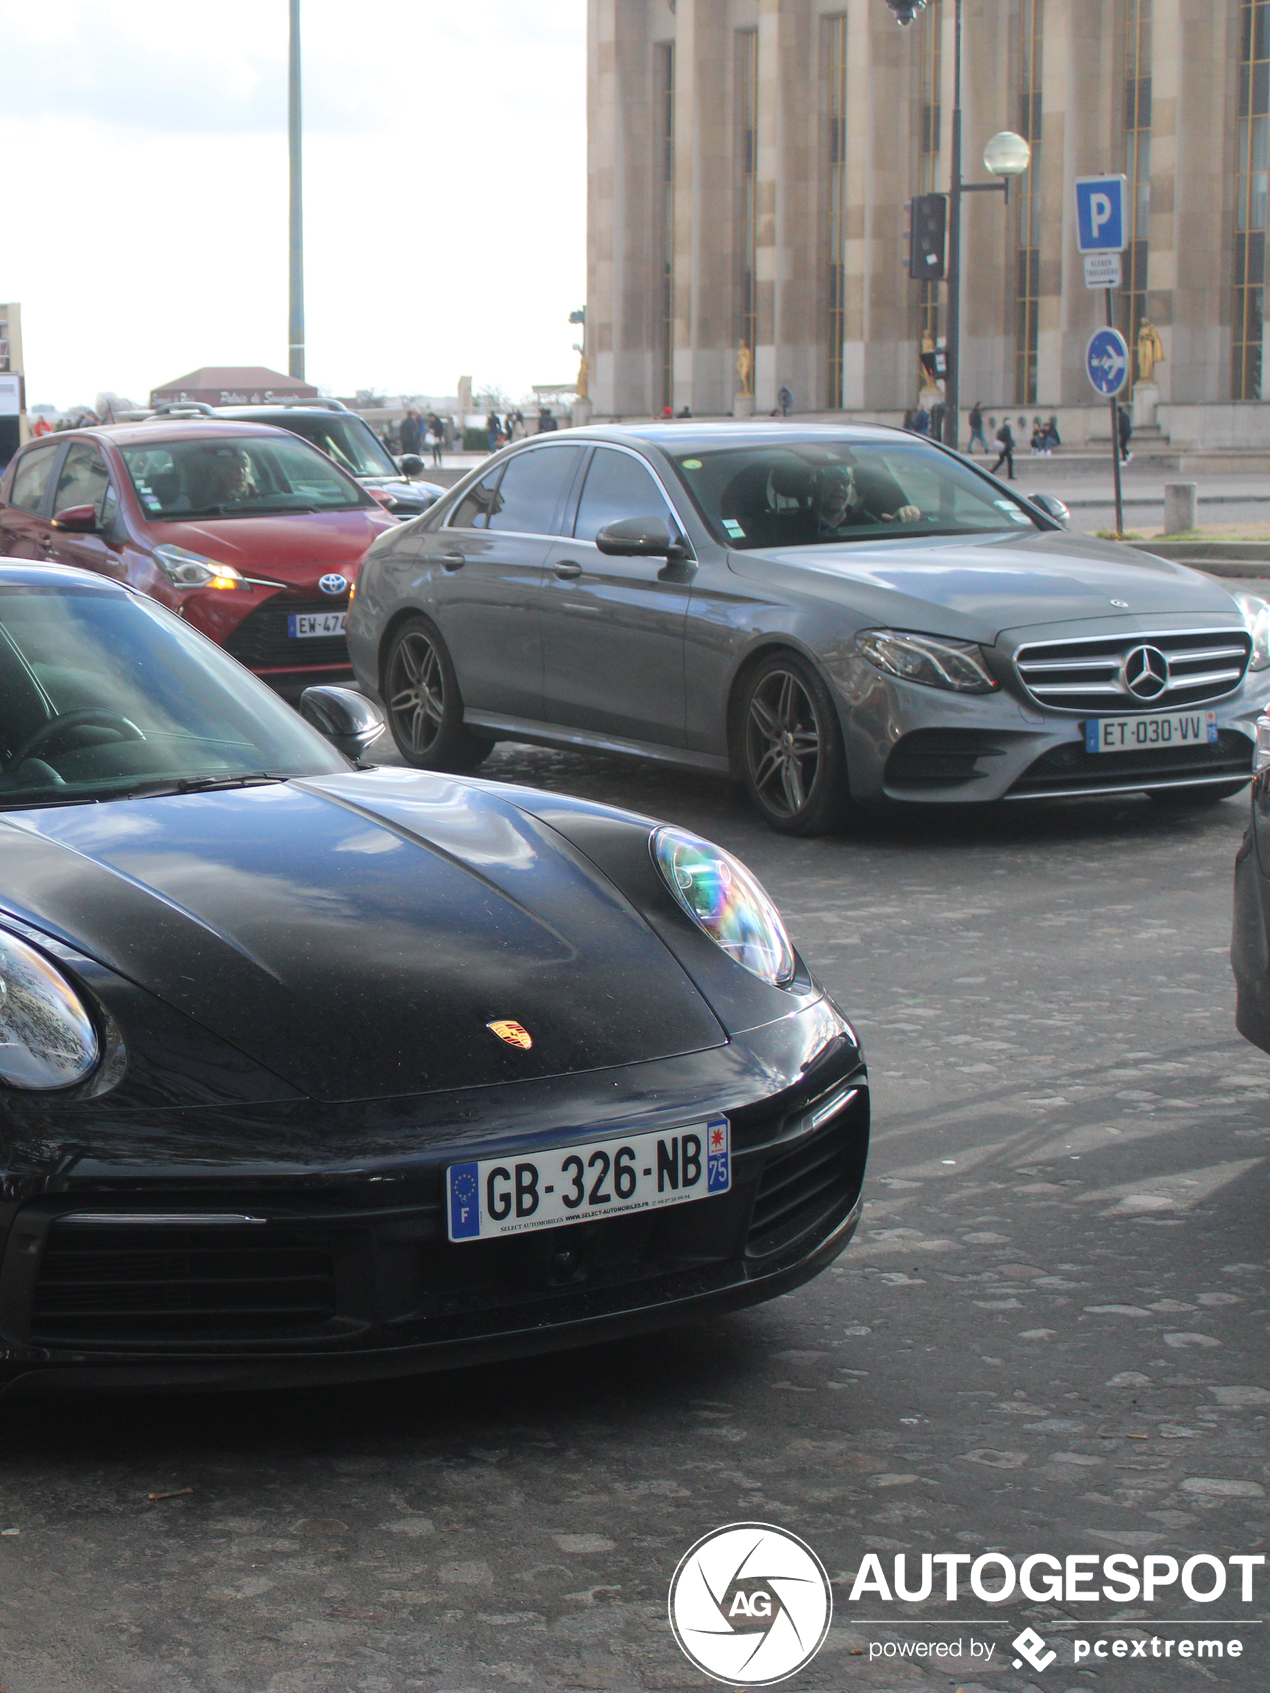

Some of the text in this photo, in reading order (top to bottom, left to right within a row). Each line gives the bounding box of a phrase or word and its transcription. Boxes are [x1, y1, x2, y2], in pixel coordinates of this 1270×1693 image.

[1090, 193, 1112, 238] P
[486, 1133, 702, 1221] GB-326-NB
[709, 1158, 727, 1185] 75
[461, 1207, 469, 1223] F
[500, 1223, 522, 1232] SELECT
[522, 1217, 564, 1229] AUTOMOBILES
[565, 1201, 649, 1221] WWW.SELECT-AUTOMOBILES.FR
